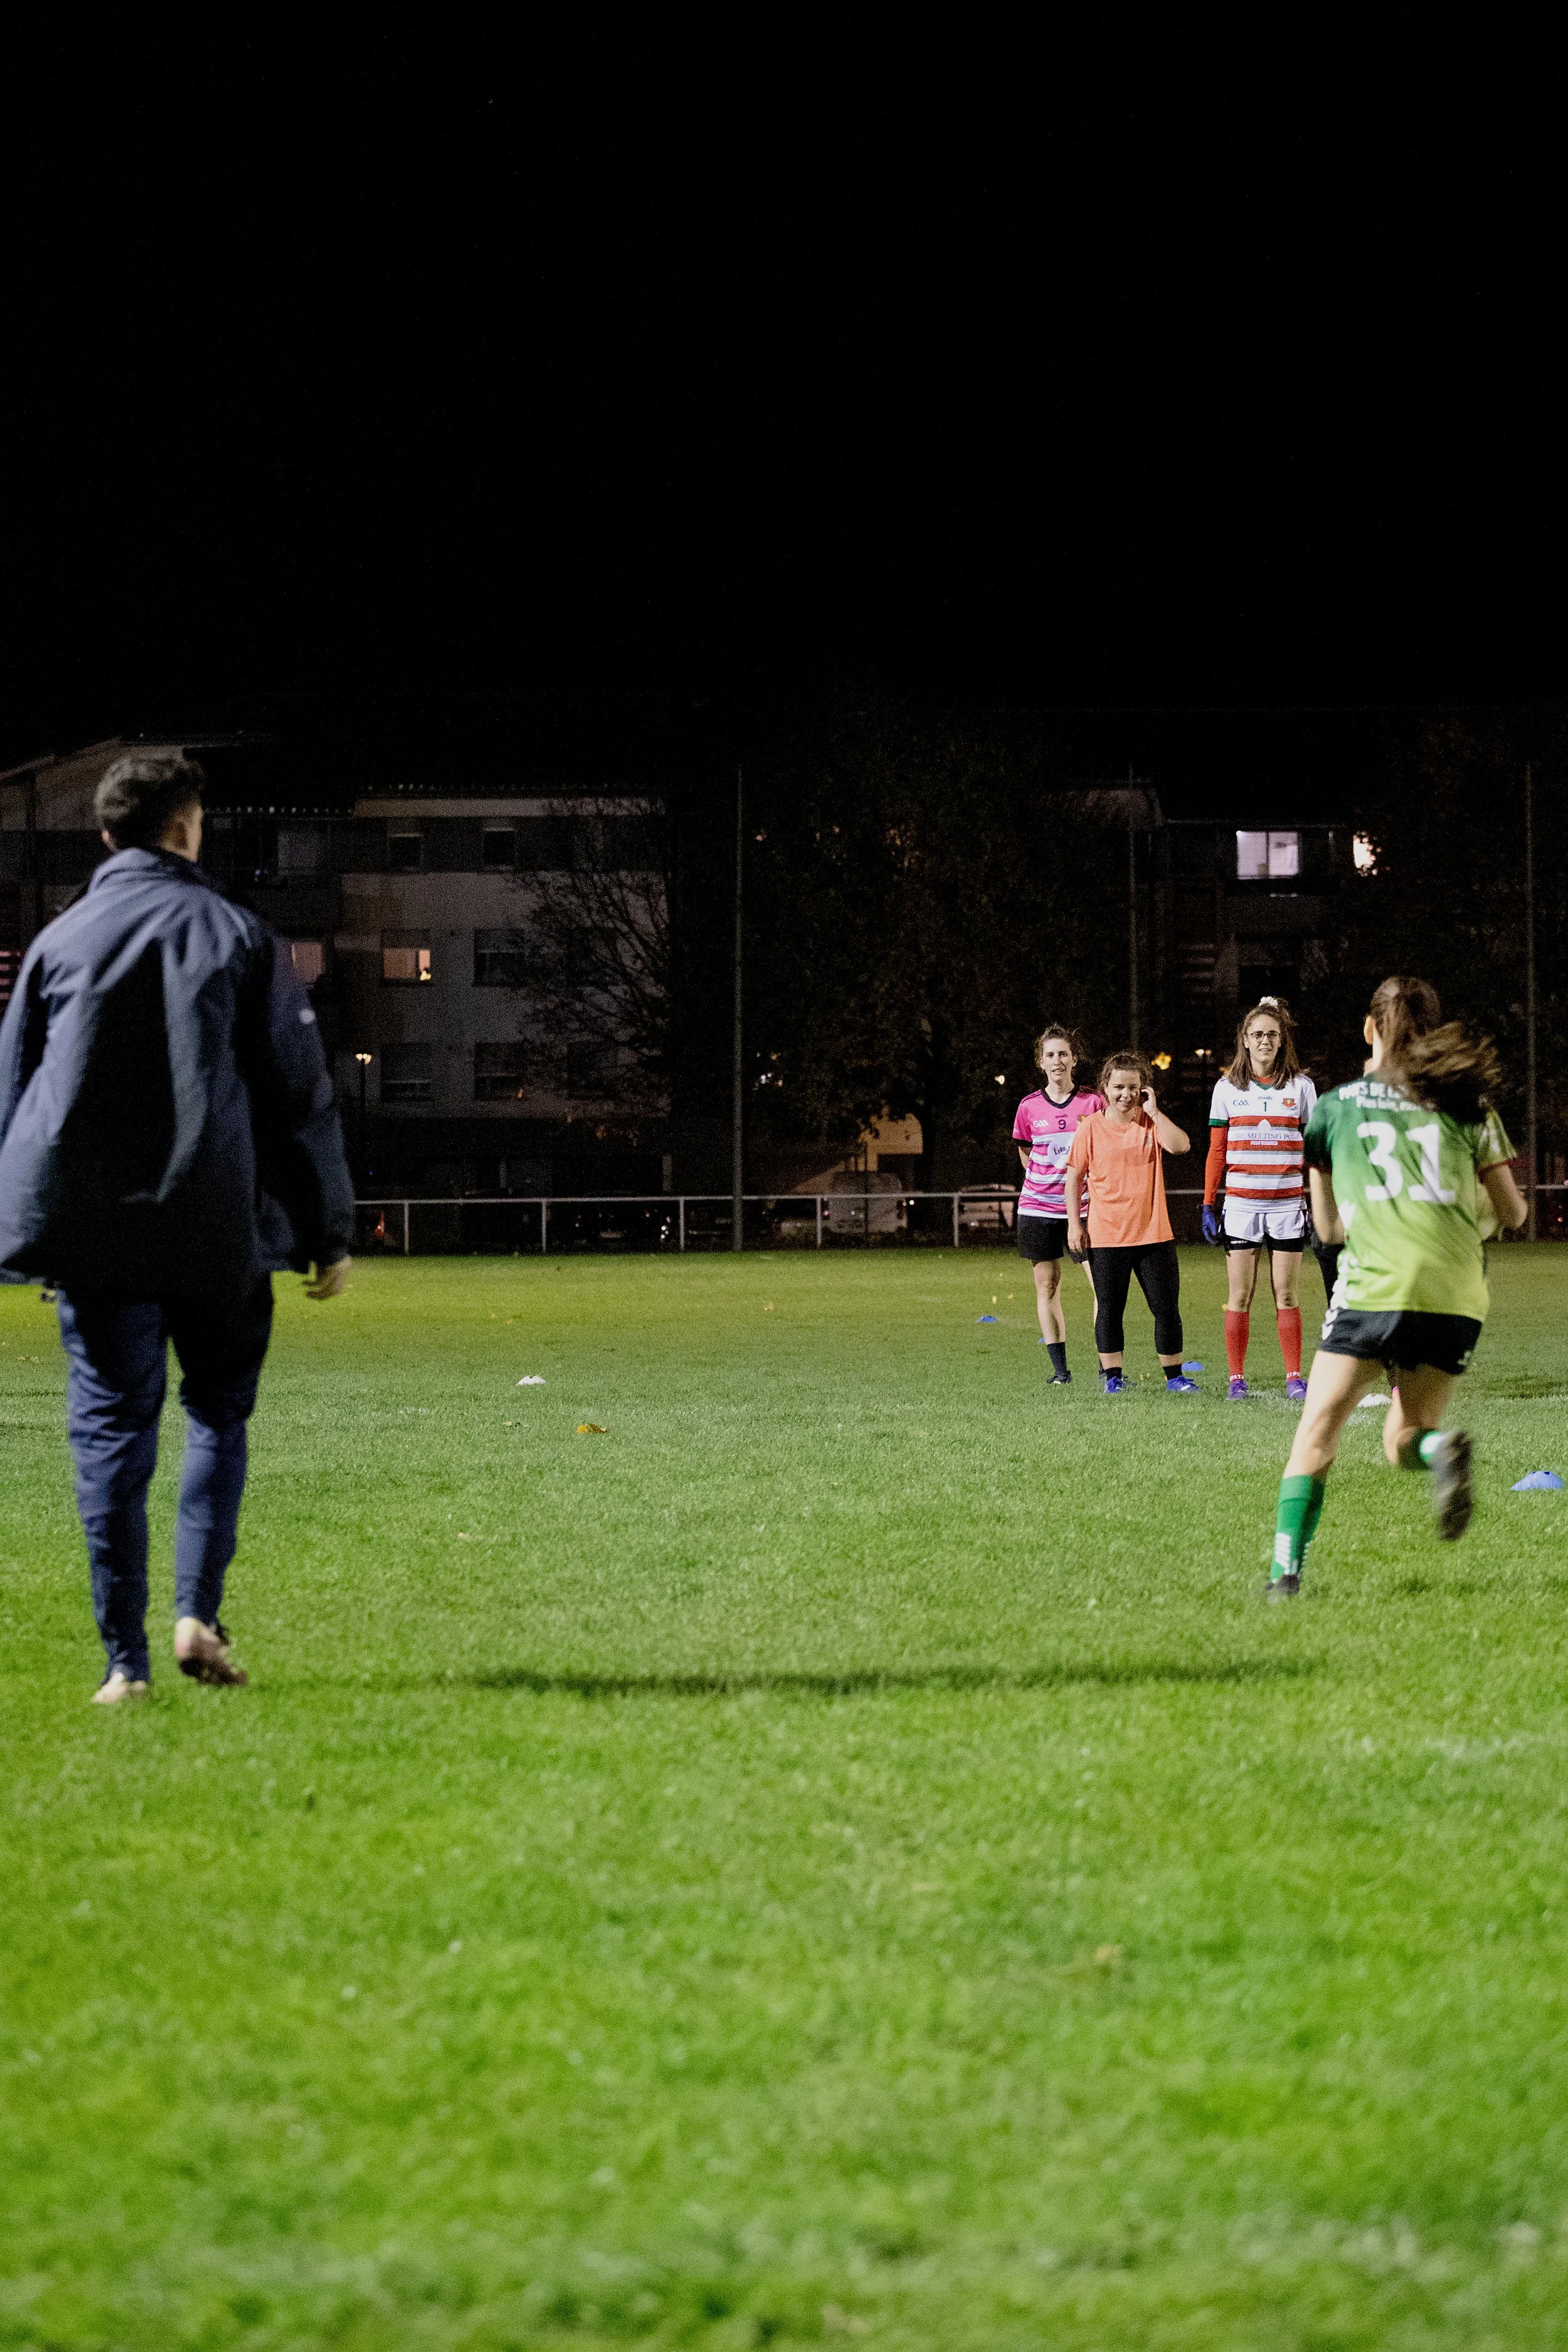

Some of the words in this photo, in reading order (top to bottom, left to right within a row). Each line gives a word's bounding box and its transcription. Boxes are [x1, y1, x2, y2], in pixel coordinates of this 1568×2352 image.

[1263, 1101, 1268, 1112] 1
[1058, 1120, 1066, 1130] 9
[1357, 1121, 1456, 1203] 31
